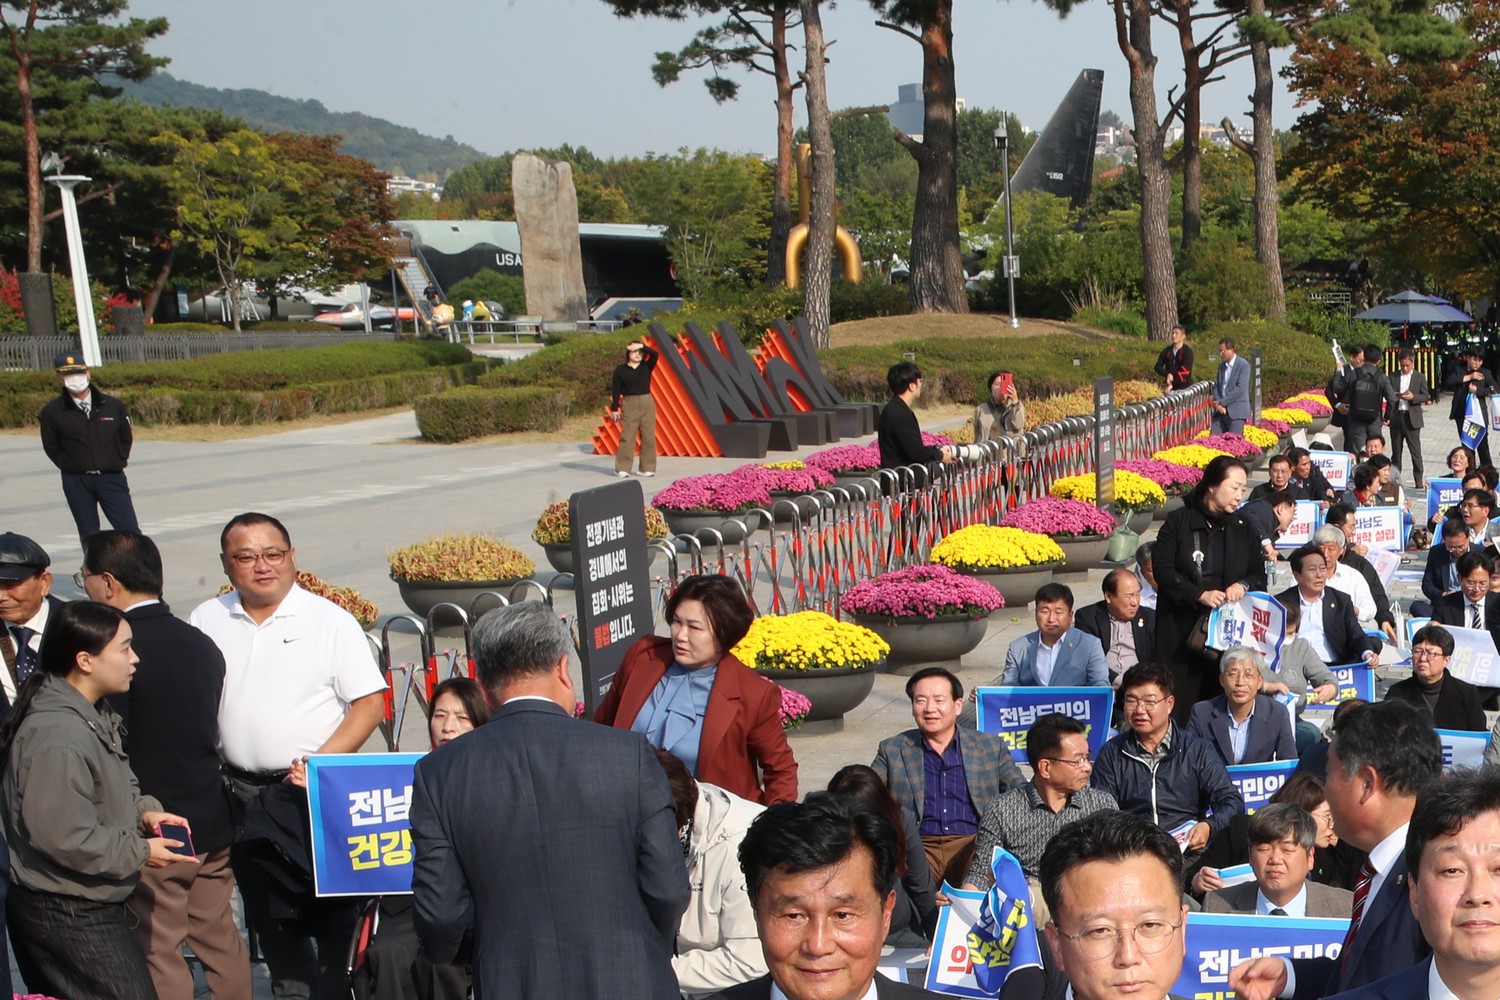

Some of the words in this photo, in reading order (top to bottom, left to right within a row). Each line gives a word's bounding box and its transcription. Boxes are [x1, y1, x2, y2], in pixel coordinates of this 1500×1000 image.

[1326, 470, 1343, 480] 설립
[586, 515, 625, 548] 전쟁기념관
[1289, 522, 1310, 535] 설립
[1375, 528, 1395, 542] 설립
[588, 548, 627, 582] 경내에서의
[591, 581, 634, 616] 집회·시위는
[594, 613, 636, 650] 불법입니다.
